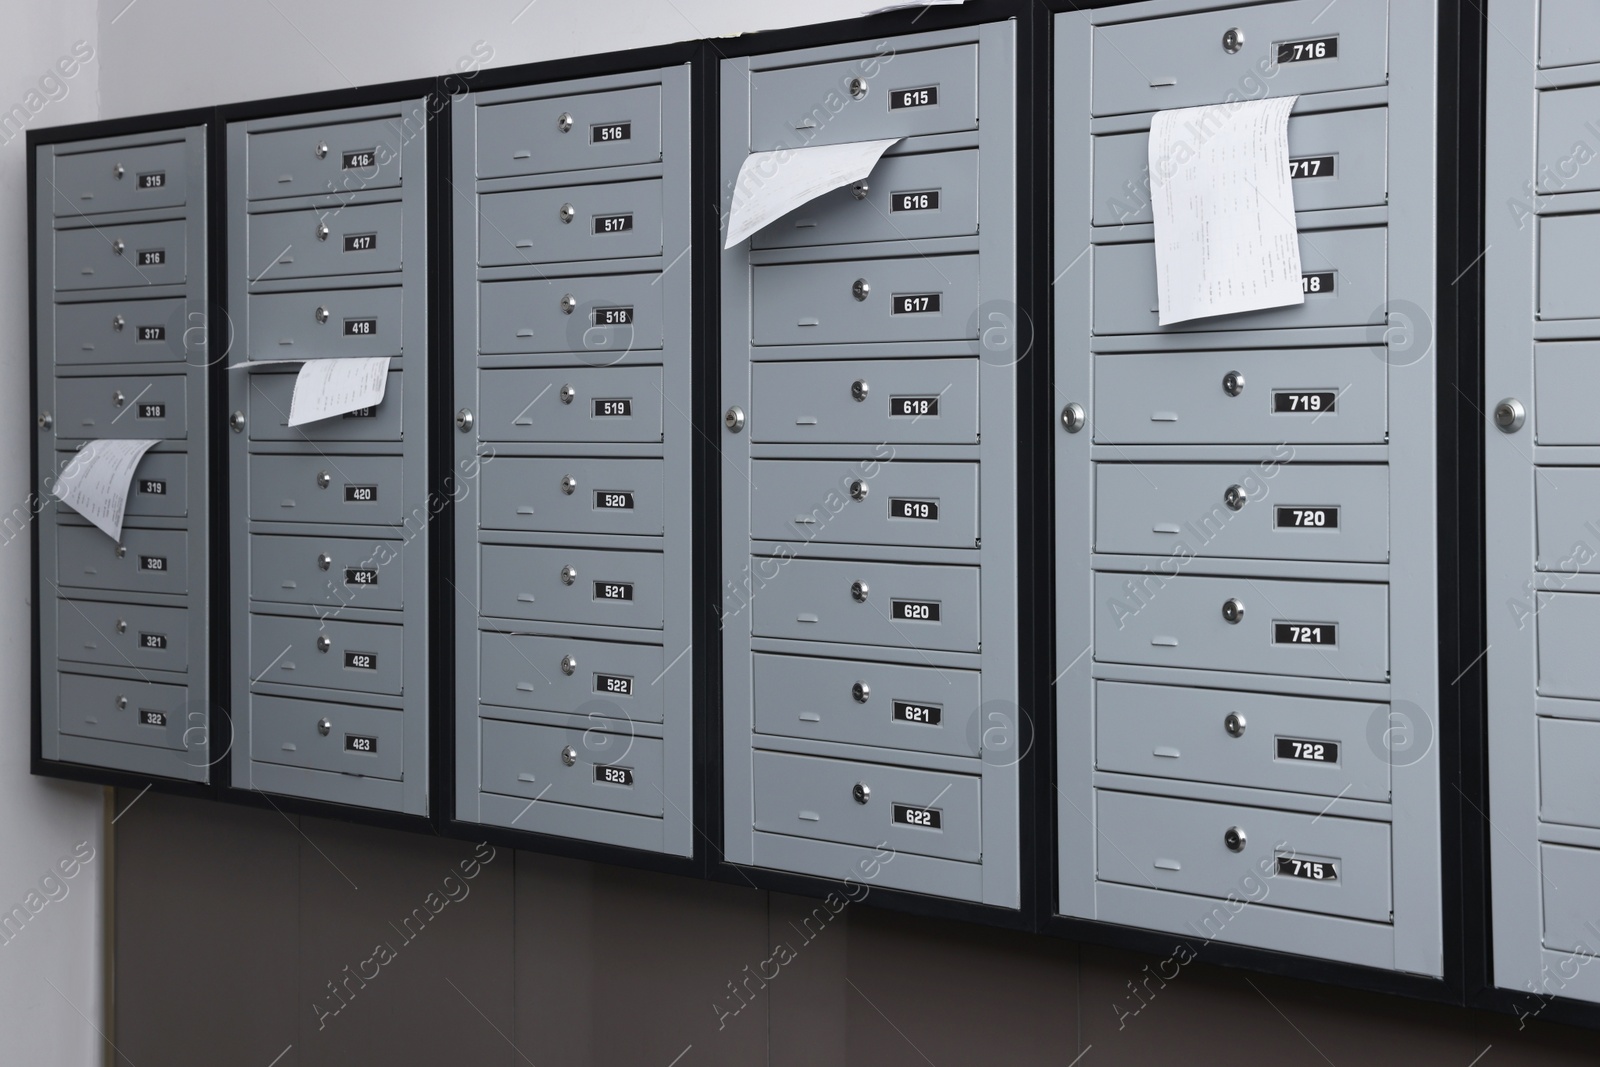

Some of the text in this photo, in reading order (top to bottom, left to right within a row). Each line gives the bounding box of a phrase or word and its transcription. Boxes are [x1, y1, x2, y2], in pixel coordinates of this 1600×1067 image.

[1293, 42, 1326, 60] 716
[903, 90, 929, 106] 615
[601, 126, 622, 141] 516
[351, 154, 369, 167] 416
[1289, 160, 1321, 177] 717
[146, 175, 161, 187] 315
[903, 194, 928, 210] 616
[604, 218, 625, 232] 517
[353, 237, 370, 249] 417
[145, 252, 160, 264] 316
[1302, 276, 1321, 292] 18
[904, 297, 929, 312] 617
[606, 310, 626, 324] 518
[144, 328, 160, 339] 317
[352, 322, 370, 334] 418
[604, 402, 625, 415] 519
[903, 400, 929, 414] 618
[1288, 395, 1321, 411] 719
[145, 405, 161, 417] 318
[146, 481, 162, 494] 319
[353, 488, 371, 500] 420
[605, 494, 626, 507] 520
[904, 502, 929, 518] 619
[1293, 510, 1325, 527] 720
[147, 558, 163, 570] 320
[354, 571, 372, 583] 421
[605, 585, 625, 599] 521
[904, 604, 929, 619] 620
[146, 635, 161, 647] 321
[1290, 626, 1321, 643] 721
[352, 655, 370, 668] 422
[607, 678, 628, 693] 522
[147, 712, 162, 725] 322
[905, 706, 929, 723] 621
[352, 738, 370, 751] 423
[1292, 742, 1324, 760] 722
[605, 768, 625, 783] 523
[906, 809, 931, 826] 622
[1291, 859, 1324, 880] 715
